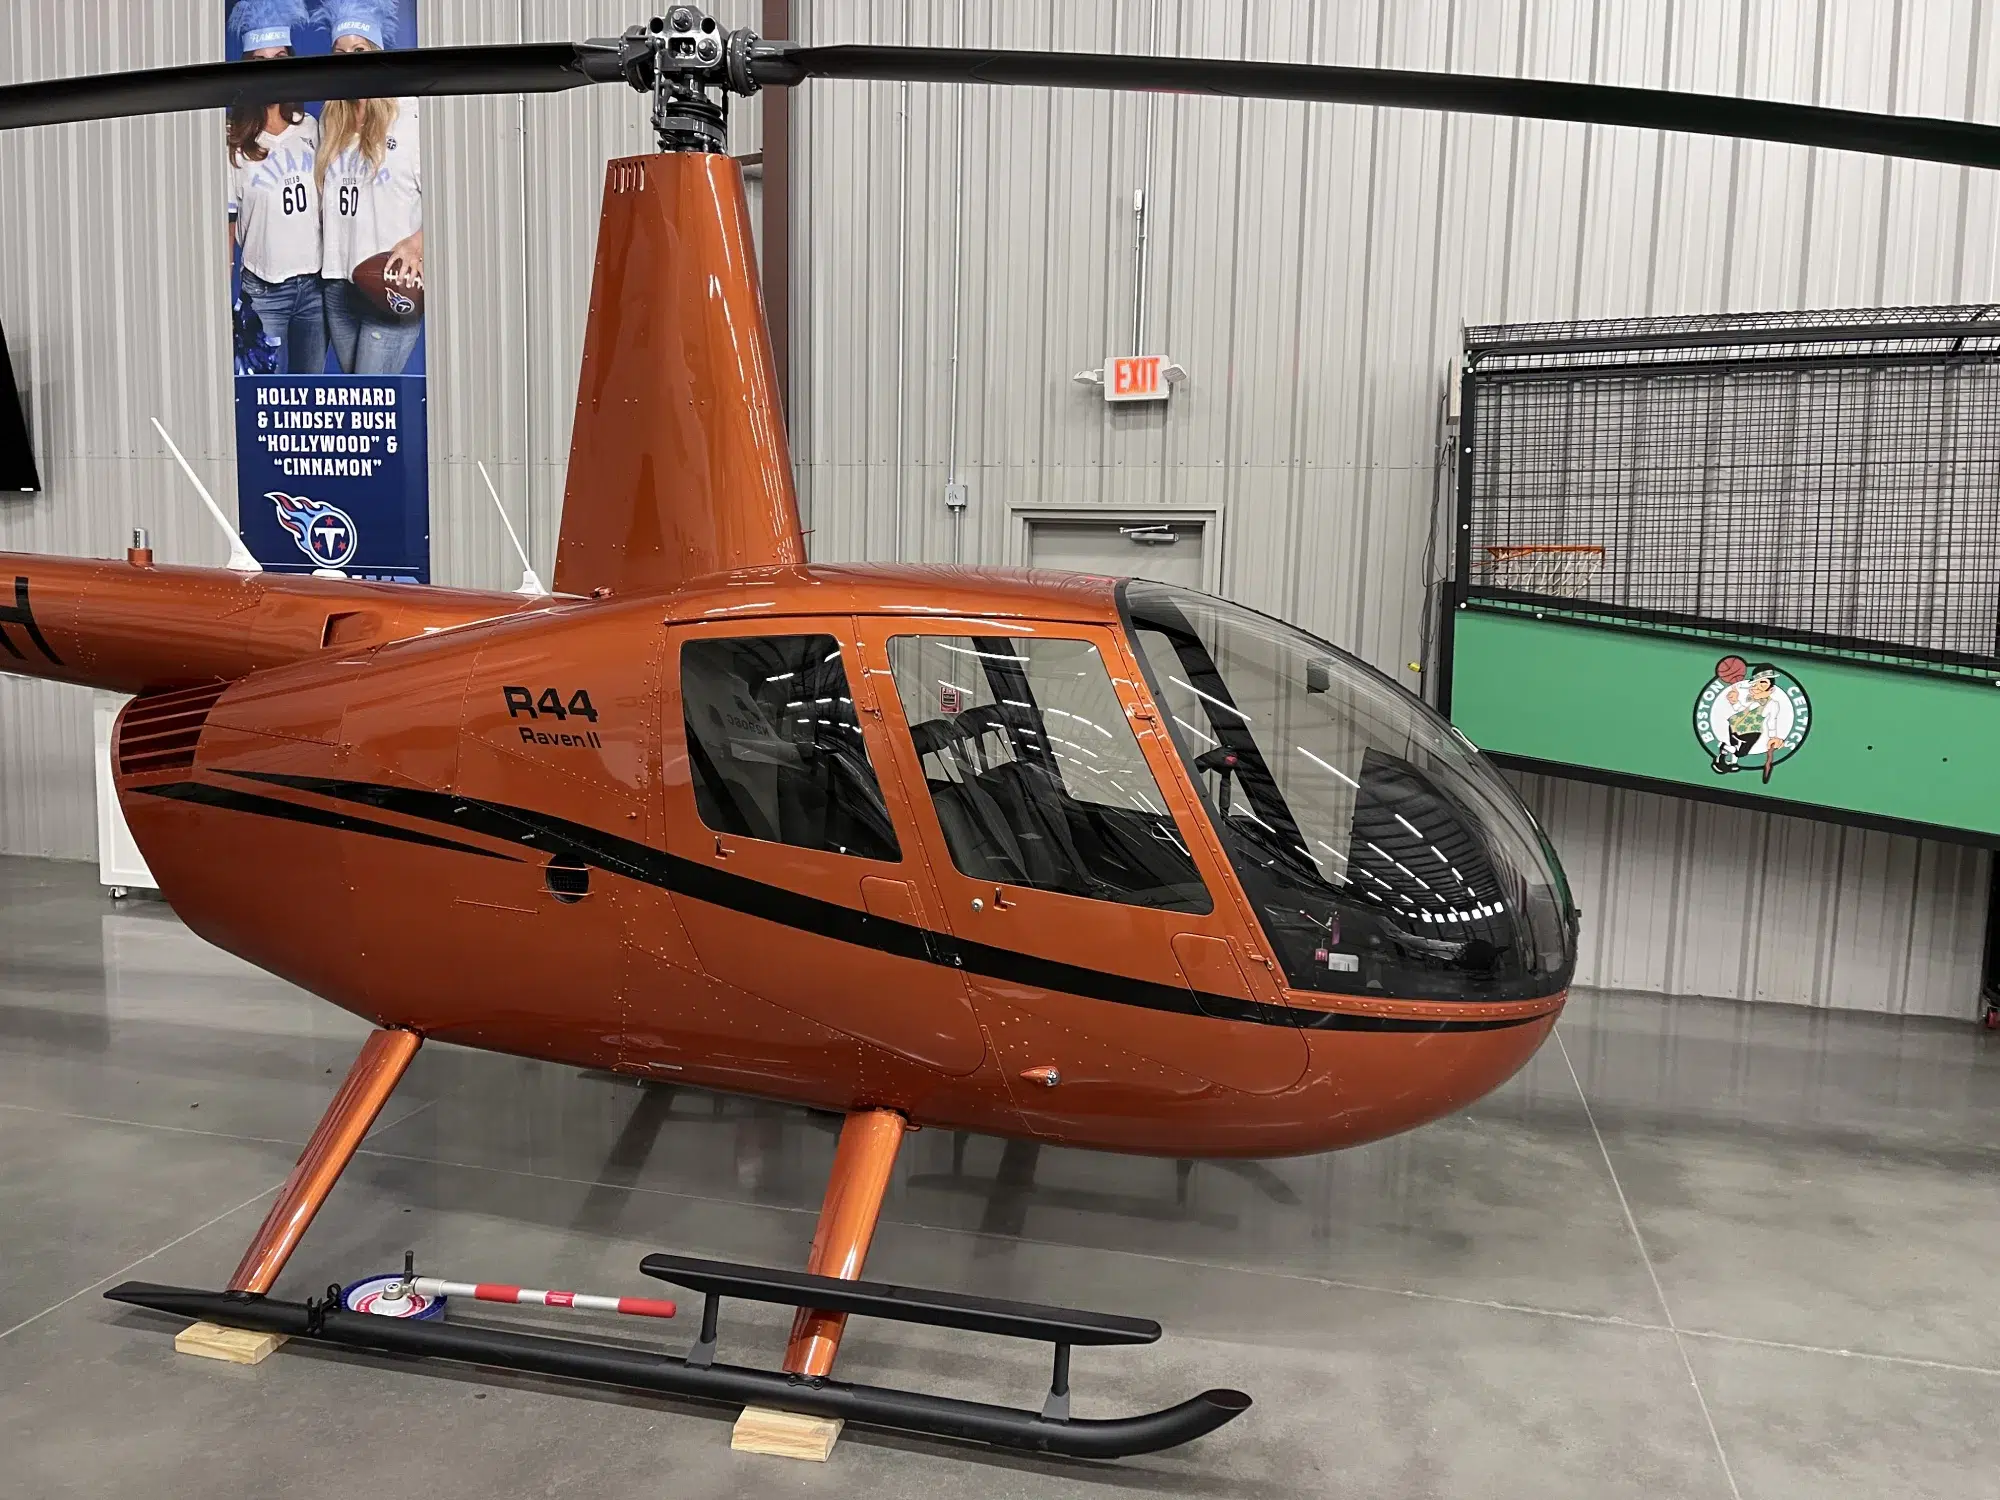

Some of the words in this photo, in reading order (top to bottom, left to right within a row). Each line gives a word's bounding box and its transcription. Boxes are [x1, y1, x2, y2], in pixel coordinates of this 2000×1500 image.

[282, 183, 307, 215] 60
[339, 185, 359, 217] 60
[1114, 357, 1161, 395] EXIT
[256, 387, 309, 406] HOLLY
[315, 387, 396, 406] BARNARD
[257, 411, 269, 429] &
[274, 411, 345, 430] LINDSEY
[351, 411, 397, 430] BUSH
[386, 435, 398, 453] &
[502, 685, 598, 723] R44
[1696, 680, 1725, 744] BOSTON
[1784, 686, 1809, 751] CELTICS
[518, 726, 587, 748] Raven
